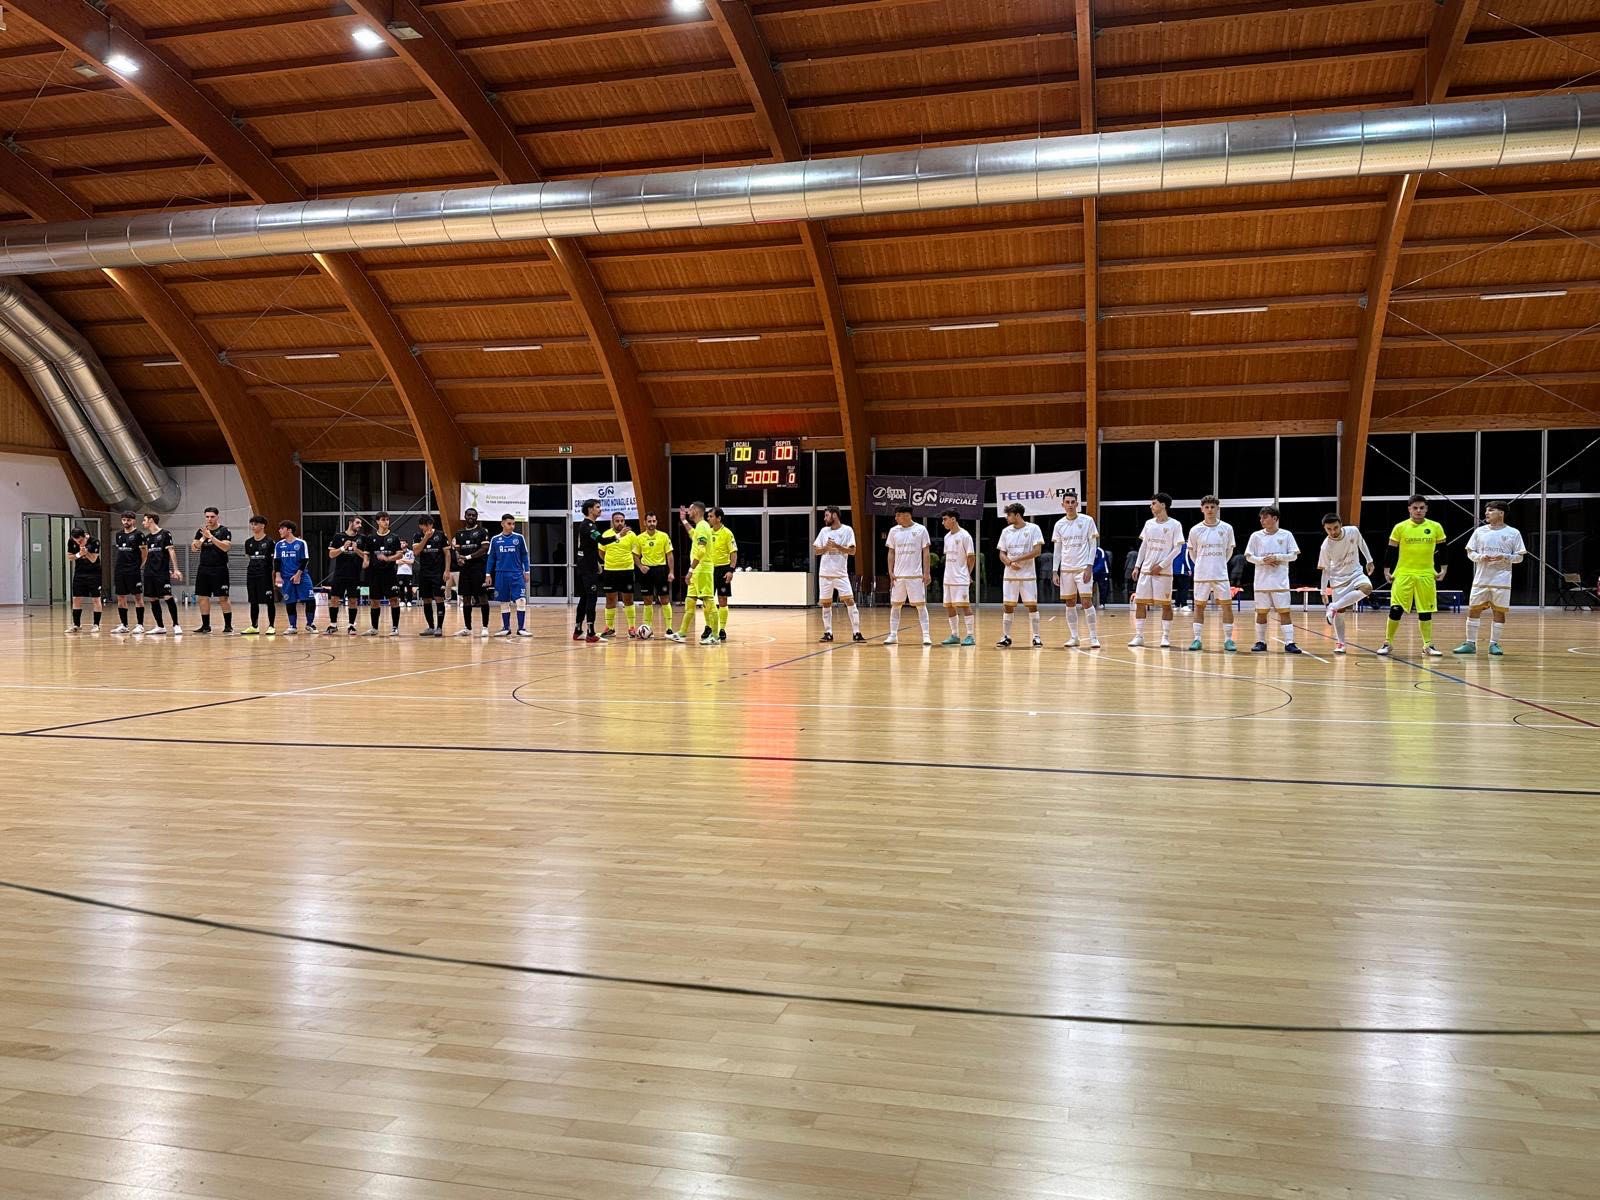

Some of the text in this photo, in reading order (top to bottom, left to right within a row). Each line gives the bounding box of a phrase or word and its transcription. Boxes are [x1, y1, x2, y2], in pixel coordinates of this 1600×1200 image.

[735, 447, 752, 461] 00
[758, 450, 765, 460] 0
[776, 446, 793, 460] 00
[732, 474, 738, 484] 0
[745, 470, 779, 484] 2000
[788, 473, 796, 484] 0
[940, 497, 978, 506] UFFICIALE
